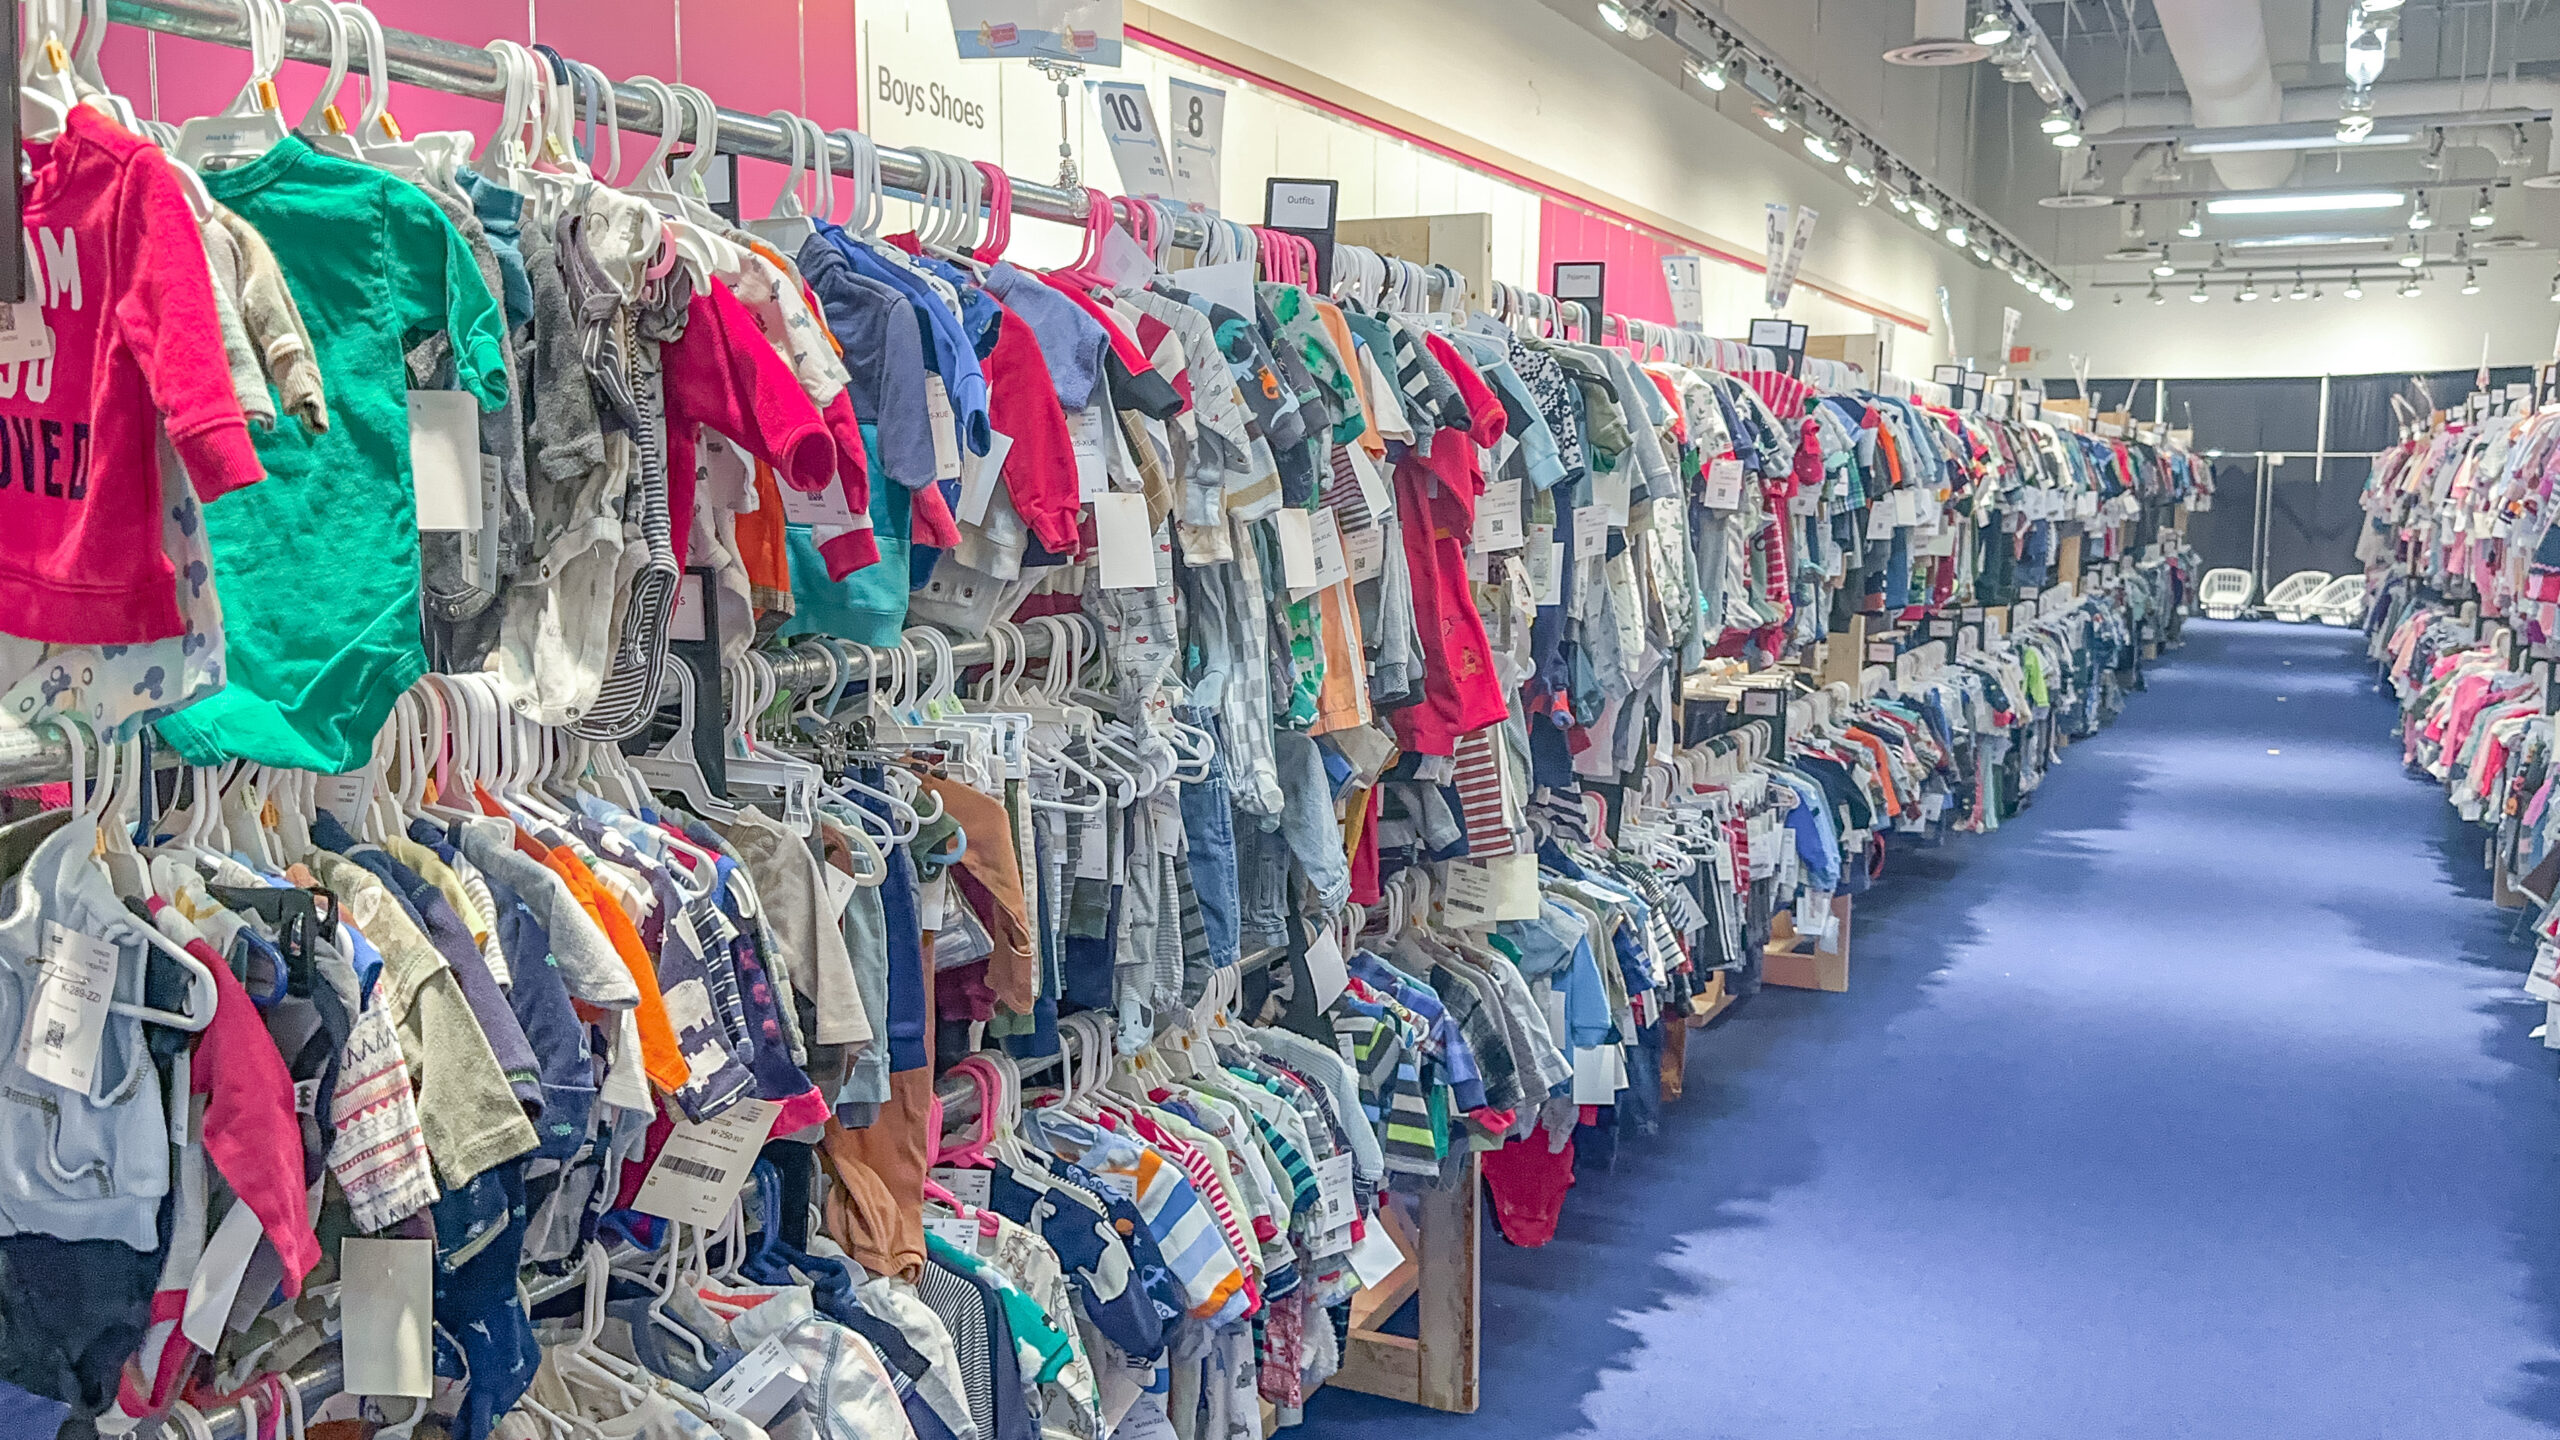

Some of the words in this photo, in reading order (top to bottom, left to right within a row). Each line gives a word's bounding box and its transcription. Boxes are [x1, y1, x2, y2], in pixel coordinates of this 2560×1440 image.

[878, 65, 925, 116] Boys
[929, 82, 984, 129] Shoes
[1104, 92, 1142, 132] 10
[1188, 96, 1203, 138] 8
[1287, 195, 1315, 205] Outfits
